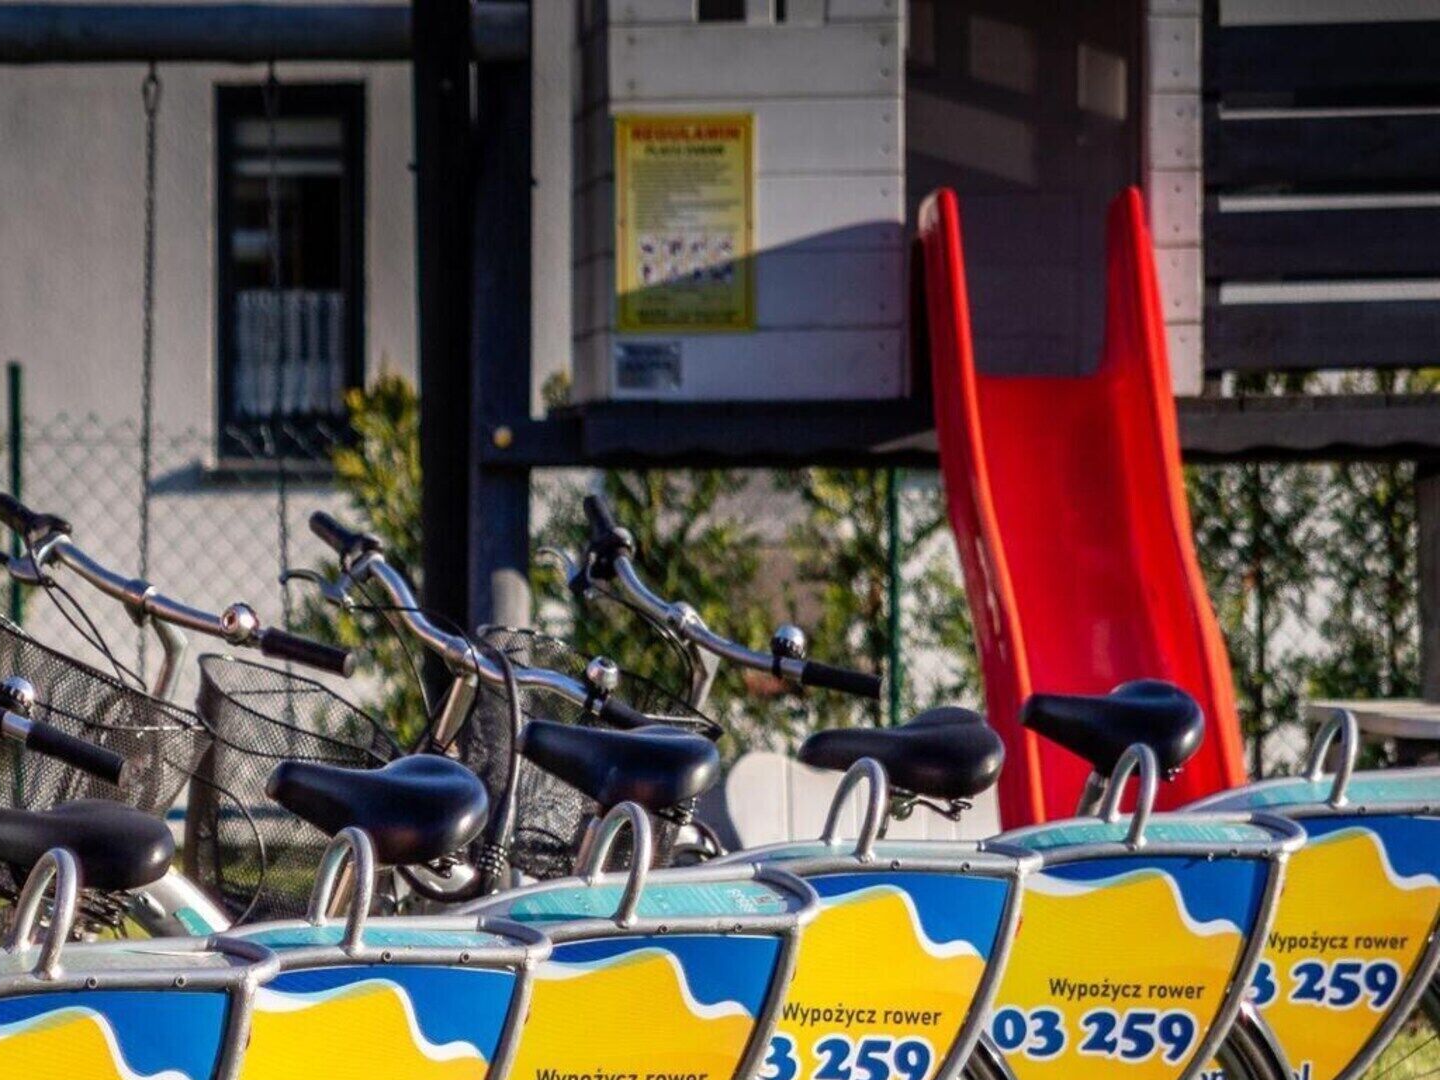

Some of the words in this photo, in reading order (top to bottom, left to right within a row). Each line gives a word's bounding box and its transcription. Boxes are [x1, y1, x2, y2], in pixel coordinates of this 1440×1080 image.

[1354, 936, 1408, 950] rower
[1049, 977, 1140, 1002] Wypożycz
[1149, 984, 1205, 999] rower
[1290, 961, 1399, 1009] 259
[782, 1002, 877, 1028] Wypożycz
[883, 1009, 942, 1026] rower
[991, 1008, 1066, 1058] 03
[1080, 1010, 1196, 1062] 259
